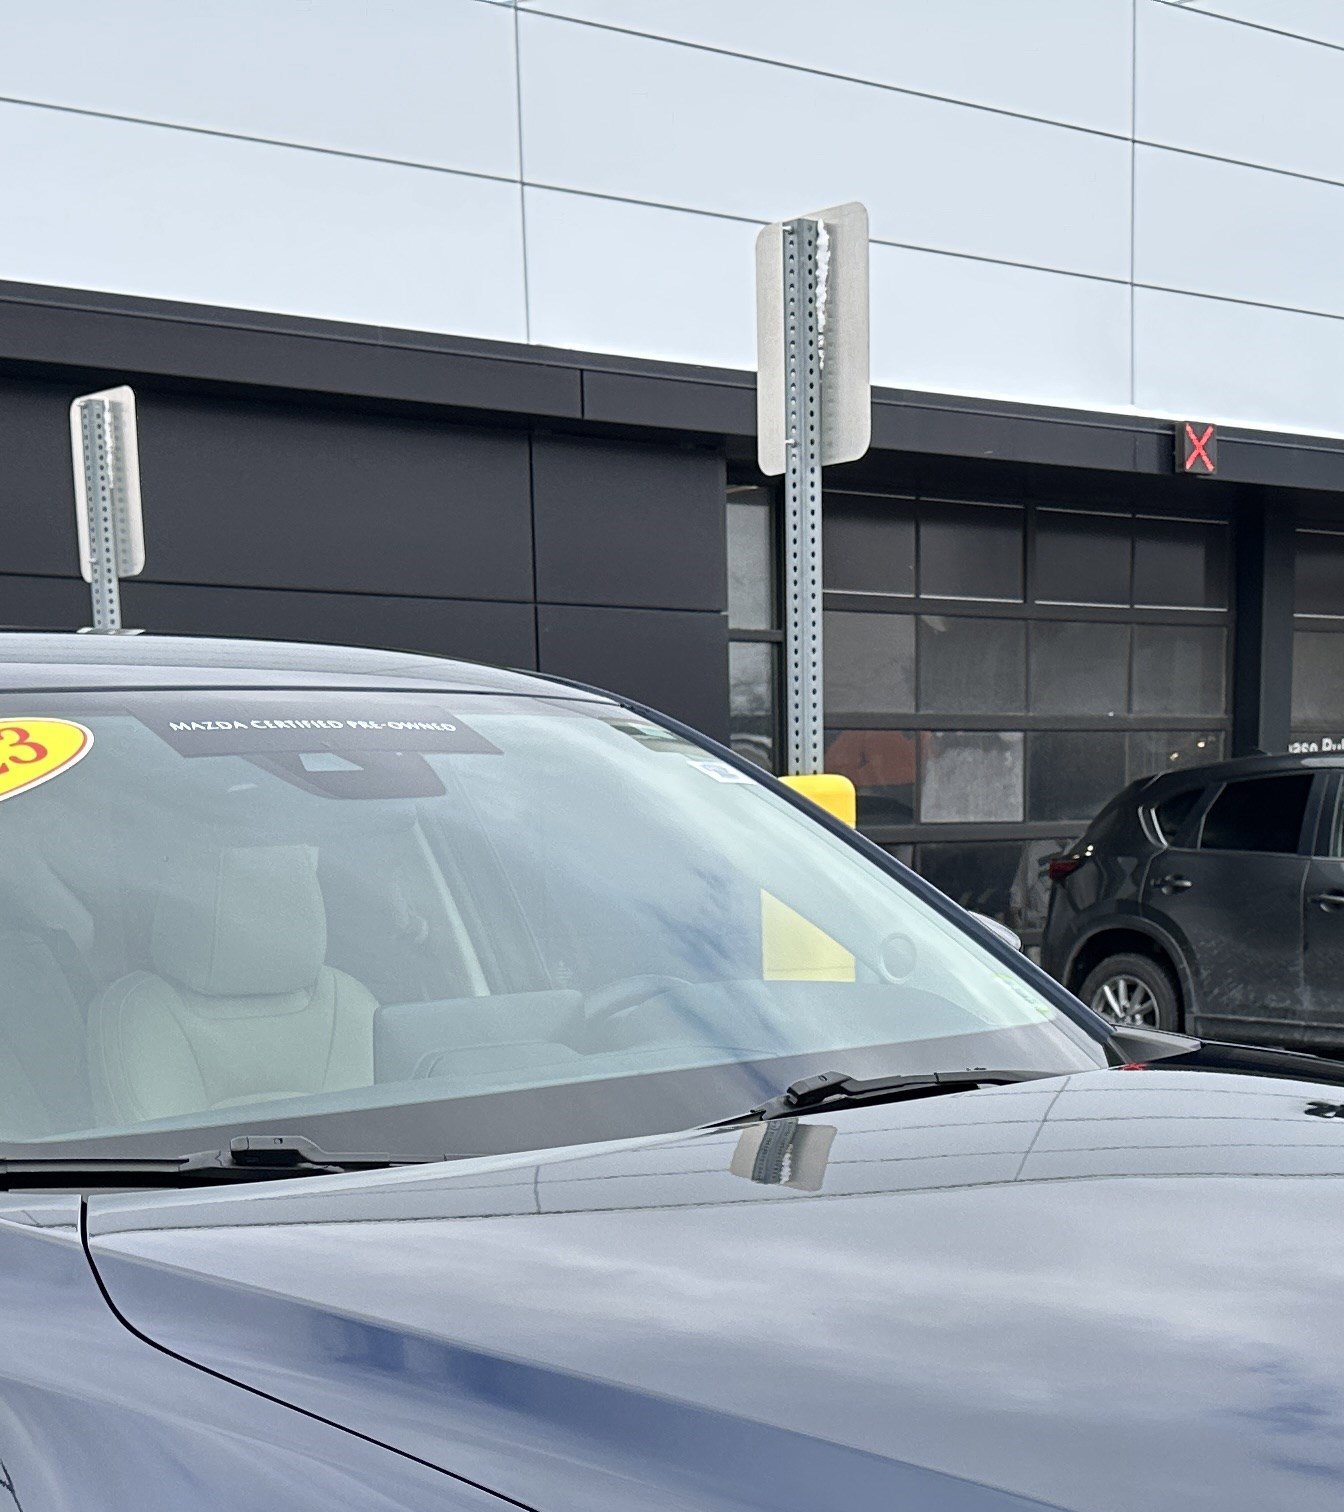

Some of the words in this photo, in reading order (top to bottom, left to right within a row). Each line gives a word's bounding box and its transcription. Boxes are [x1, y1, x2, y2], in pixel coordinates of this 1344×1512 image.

[169, 720, 249, 731] MAZDA
[251, 719, 344, 729] CERTIFIED
[346, 720, 457, 732] PRE-OWNED
